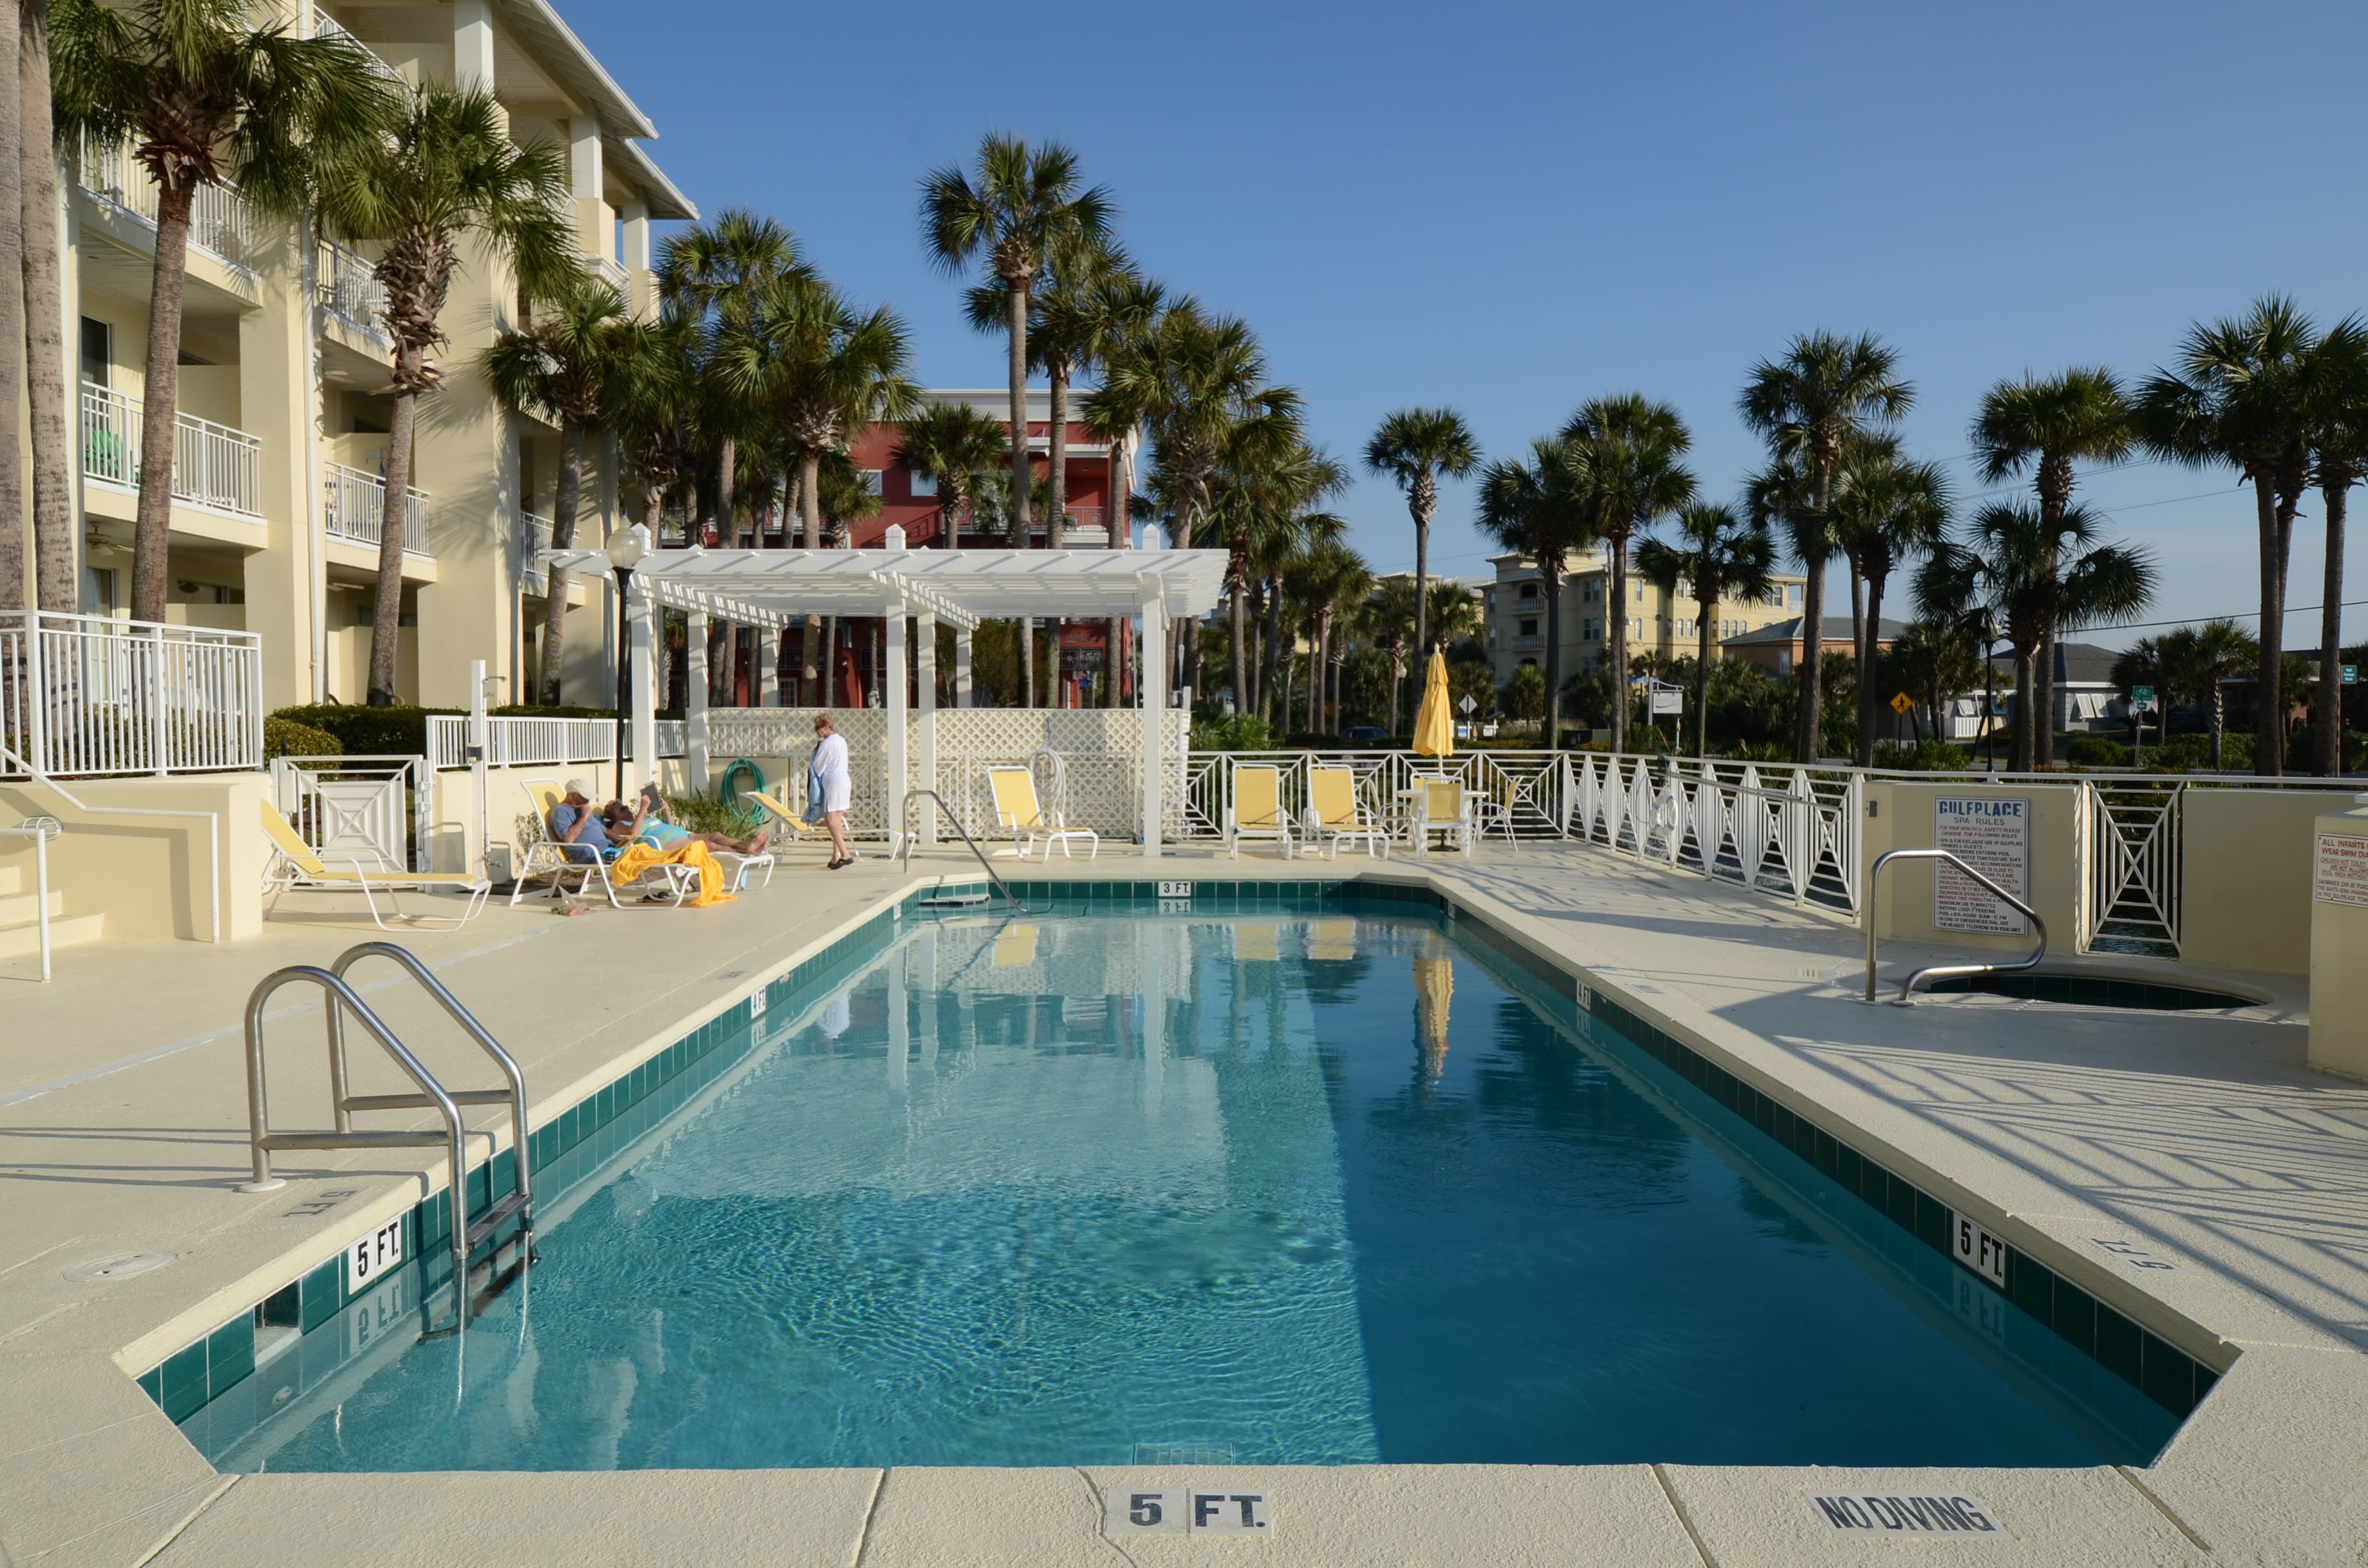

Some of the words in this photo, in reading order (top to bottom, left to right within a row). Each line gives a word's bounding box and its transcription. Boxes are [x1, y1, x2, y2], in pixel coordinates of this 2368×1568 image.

[1939, 801, 2022, 817] GULFPLACE
[2321, 847, 2339, 856] WEAR
[2322, 838, 2335, 847] ALL
[2337, 840, 2365, 849] INFANTS
[1163, 883, 1170, 894] 3
[358, 1239, 368, 1277] 5
[377, 1221, 399, 1266] FT.
[1961, 1219, 1971, 1256] 5
[1980, 1230, 2003, 1278] FT.
[1129, 1493, 1163, 1526] 5
[1194, 1494, 1266, 1528] FT.
[1814, 1496, 1875, 1530] NO
[1862, 1496, 1997, 1531] DIVING
